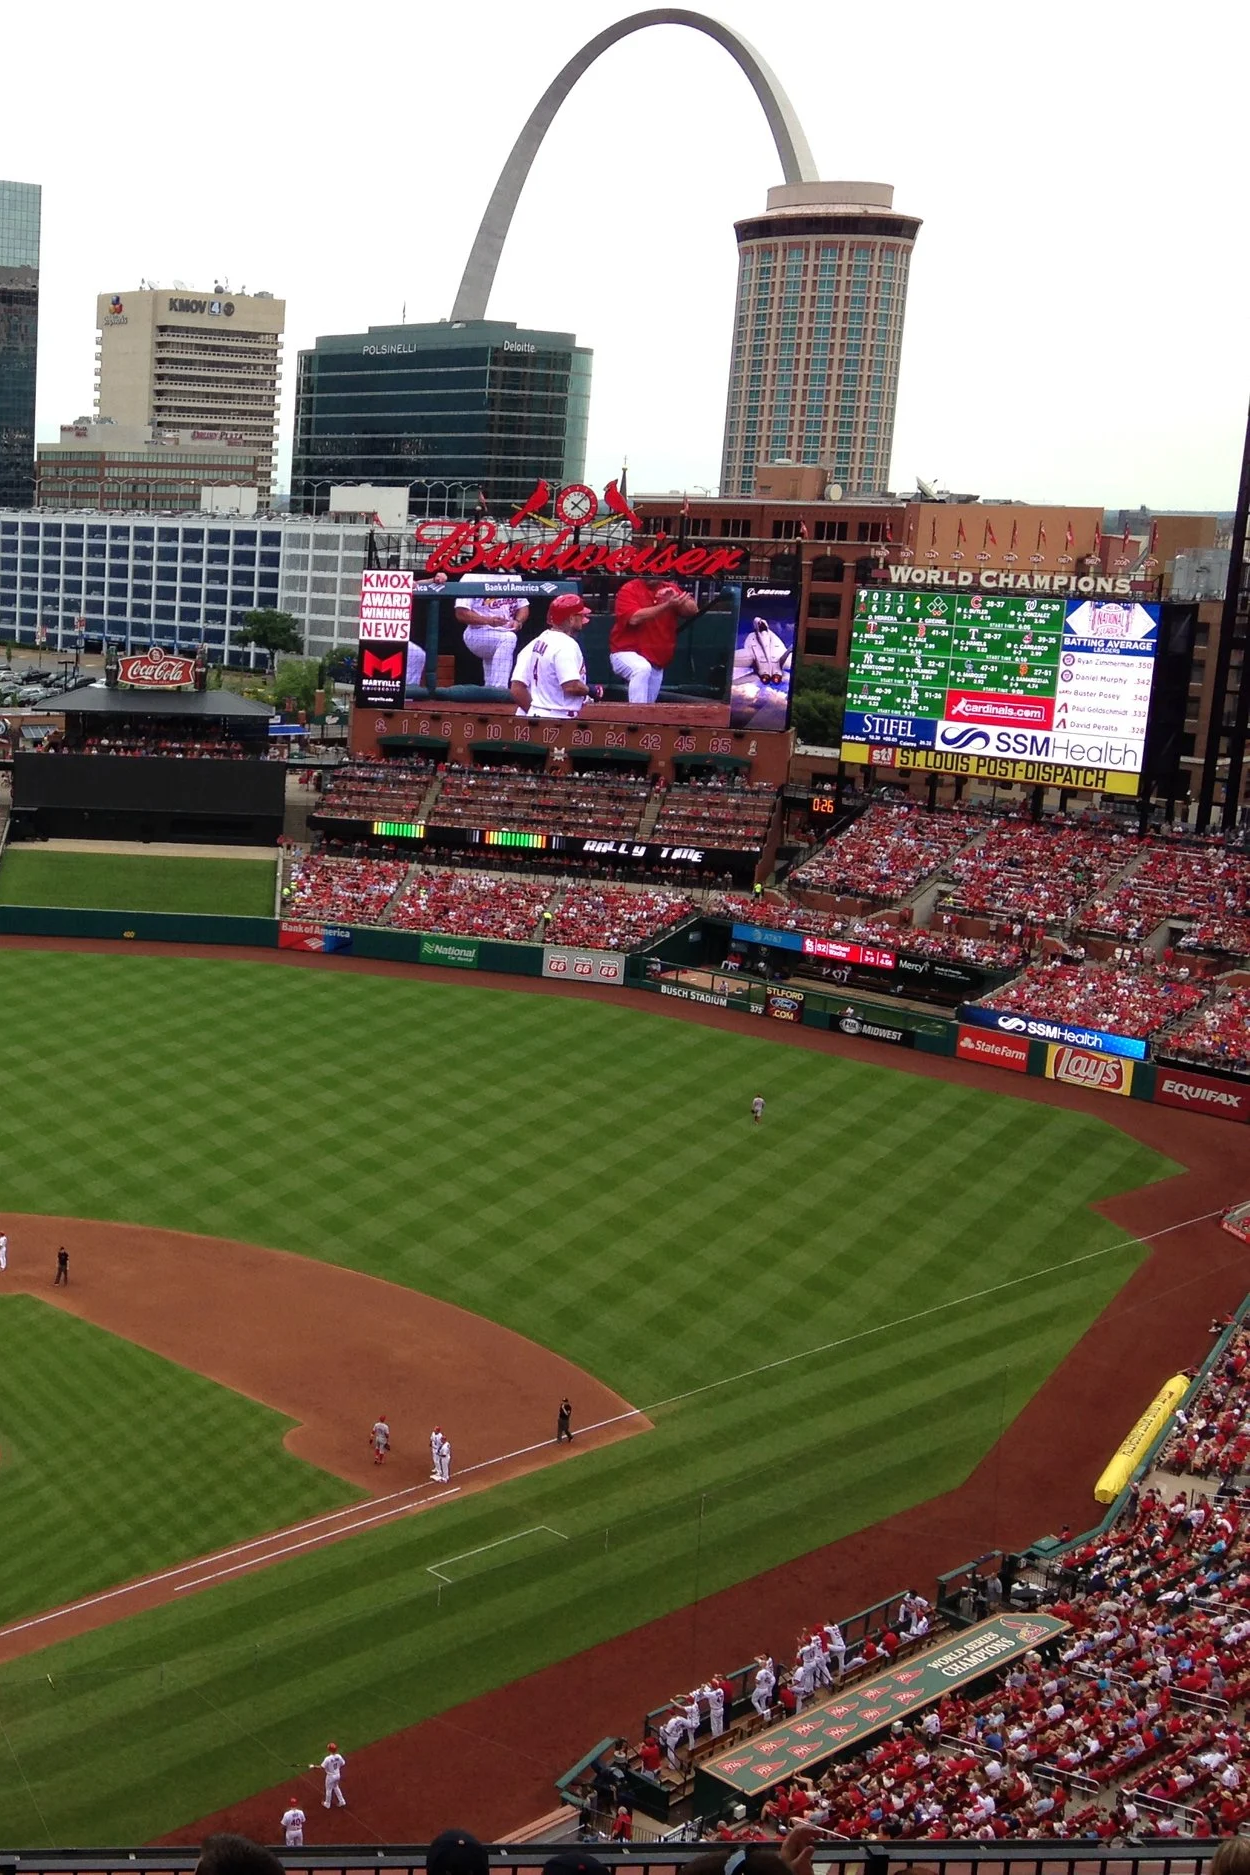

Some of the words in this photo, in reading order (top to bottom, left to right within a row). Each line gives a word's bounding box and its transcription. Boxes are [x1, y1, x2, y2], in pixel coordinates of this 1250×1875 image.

[169, 297, 207, 314] KMOV
[362, 343, 417, 355] POLSINELLI
[503, 339, 535, 351] Deloitte
[415, 521, 747, 576] Budweiser
[363, 573, 412, 589] KMOX
[484, 583, 504, 592] Bank
[503, 583, 510, 592] of
[509, 583, 539, 592] America
[888, 565, 973, 585] WORLD
[980, 570, 1131, 594] CHAMPIONS
[362, 592, 411, 608] AWARD
[872, 592, 879, 601] 0
[885, 593, 891, 601] 2
[985, 600, 1005, 608] 38-37
[362, 607, 410, 620] WINNING
[871, 604, 878, 613] 6
[884, 605, 890, 613] 7
[1022, 611, 1051, 619] GONZALEZ
[1040, 603, 1061, 611] 45-30
[361, 621, 409, 640] NEWS
[1019, 644, 1049, 652] CARRASCO
[1064, 637, 1105, 647] BATTING
[1106, 640, 1153, 651] AVERAGE
[126, 660, 184, 681] Coca-Cola
[1077, 657, 1093, 666] Ryan
[1094, 658, 1134, 668] Zimmerman
[362, 679, 401, 688] MARYVILLE
[1075, 673, 1098, 682] Daniel
[1100, 675, 1128, 685] Murphy
[1133, 677, 1150, 686] .342
[1073, 689, 1097, 698] Buster
[1098, 691, 1120, 700] Posey
[964, 703, 1042, 719] cardinals.com
[1071, 704, 1086, 712] Paul
[1087, 705, 1128, 716] Goldschmidt
[402, 719, 409, 735] 1
[418, 720, 430, 736] 2
[441, 721, 452, 737] 6
[463, 722, 475, 739] 9
[486, 724, 502, 740] 10
[514, 725, 530, 742] 14
[862, 713, 916, 738] STIFEL
[1069, 720, 1091, 729] David
[1092, 722, 1118, 732] Peralta
[542, 726, 560, 744] 17
[571, 729, 593, 746] 20
[604, 731, 626, 748] 24
[639, 732, 662, 751] 42
[673, 735, 697, 752] 45
[708, 737, 732, 755] 85
[899, 748, 920, 767] ST.
[925, 750, 970, 772] LOUIS
[977, 757, 1107, 789] POST-DISPATCH
[812, 798, 834, 814] 0:26
[582, 840, 647, 857] RALLY
[123, 930, 135, 939] 400
[281, 922, 303, 933] Bank
[303, 924, 314, 934] of
[313, 925, 351, 938] America
[763, 934, 782, 943] AT&T
[434, 944, 476, 958] National
[816, 944, 826, 953] 52
[550, 962, 564, 971] 66
[575, 964, 590, 973] 66
[600, 967, 615, 975] 66
[898, 959, 925, 974] Mercy
[660, 984, 689, 1000] BUSCH
[690, 990, 727, 1008] STADIUM
[766, 986, 804, 1001] STLFORD
[749, 1004, 763, 1014] 375
[774, 999, 793, 1010] Ford
[771, 1009, 795, 1020] .COM
[861, 1024, 903, 1041] MIDWEST
[1056, 1046, 1121, 1084] Lay's
[1161, 1079, 1241, 1108] EQUIFAX
[926, 1647, 967, 1672] WORLD
[965, 1630, 1001, 1654] SERIES
[940, 1636, 1017, 1678] CHAMPIONS
